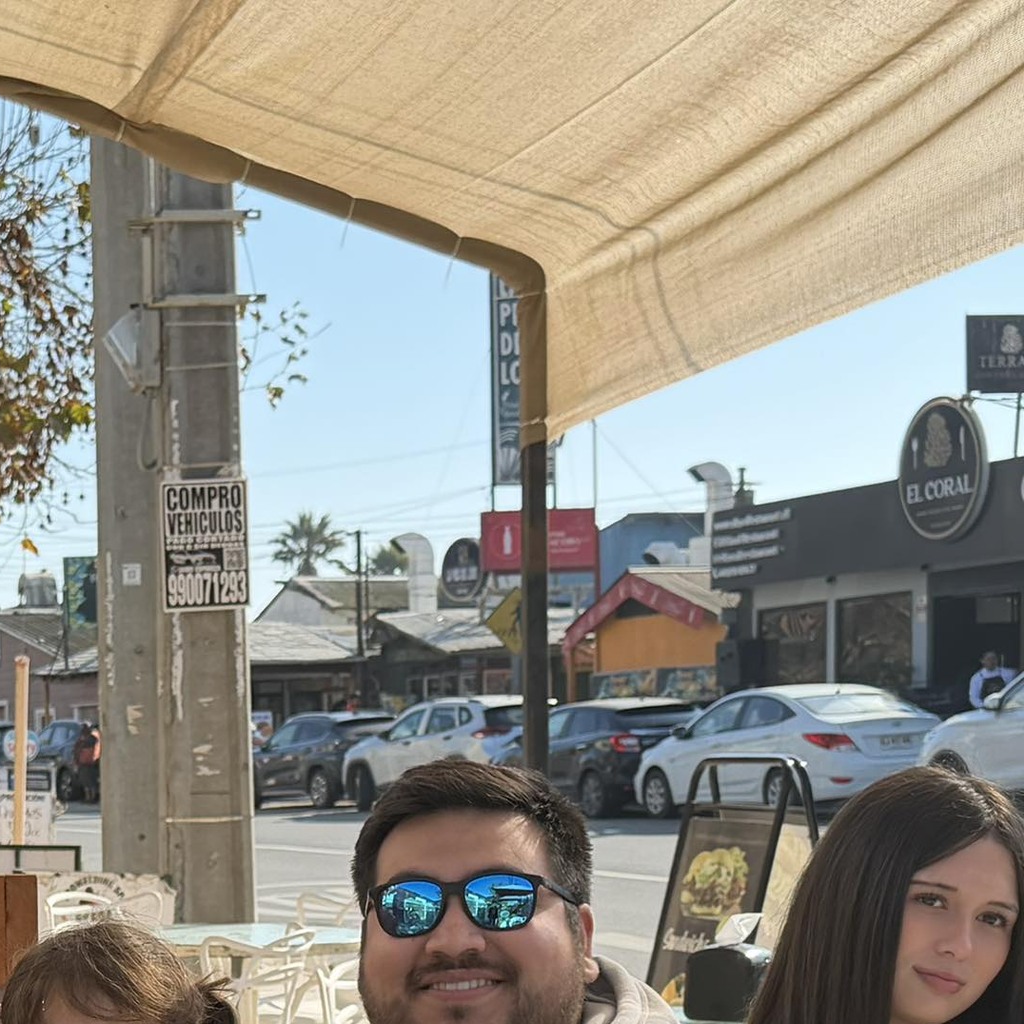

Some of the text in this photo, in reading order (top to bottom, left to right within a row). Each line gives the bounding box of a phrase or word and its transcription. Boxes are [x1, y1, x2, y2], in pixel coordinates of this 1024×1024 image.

[166, 485, 241, 511] COMPRO
[906, 474, 975, 505] EL CORAL
[167, 510, 243, 535] VEHICULOS
[167, 570, 247, 606] 990071293
